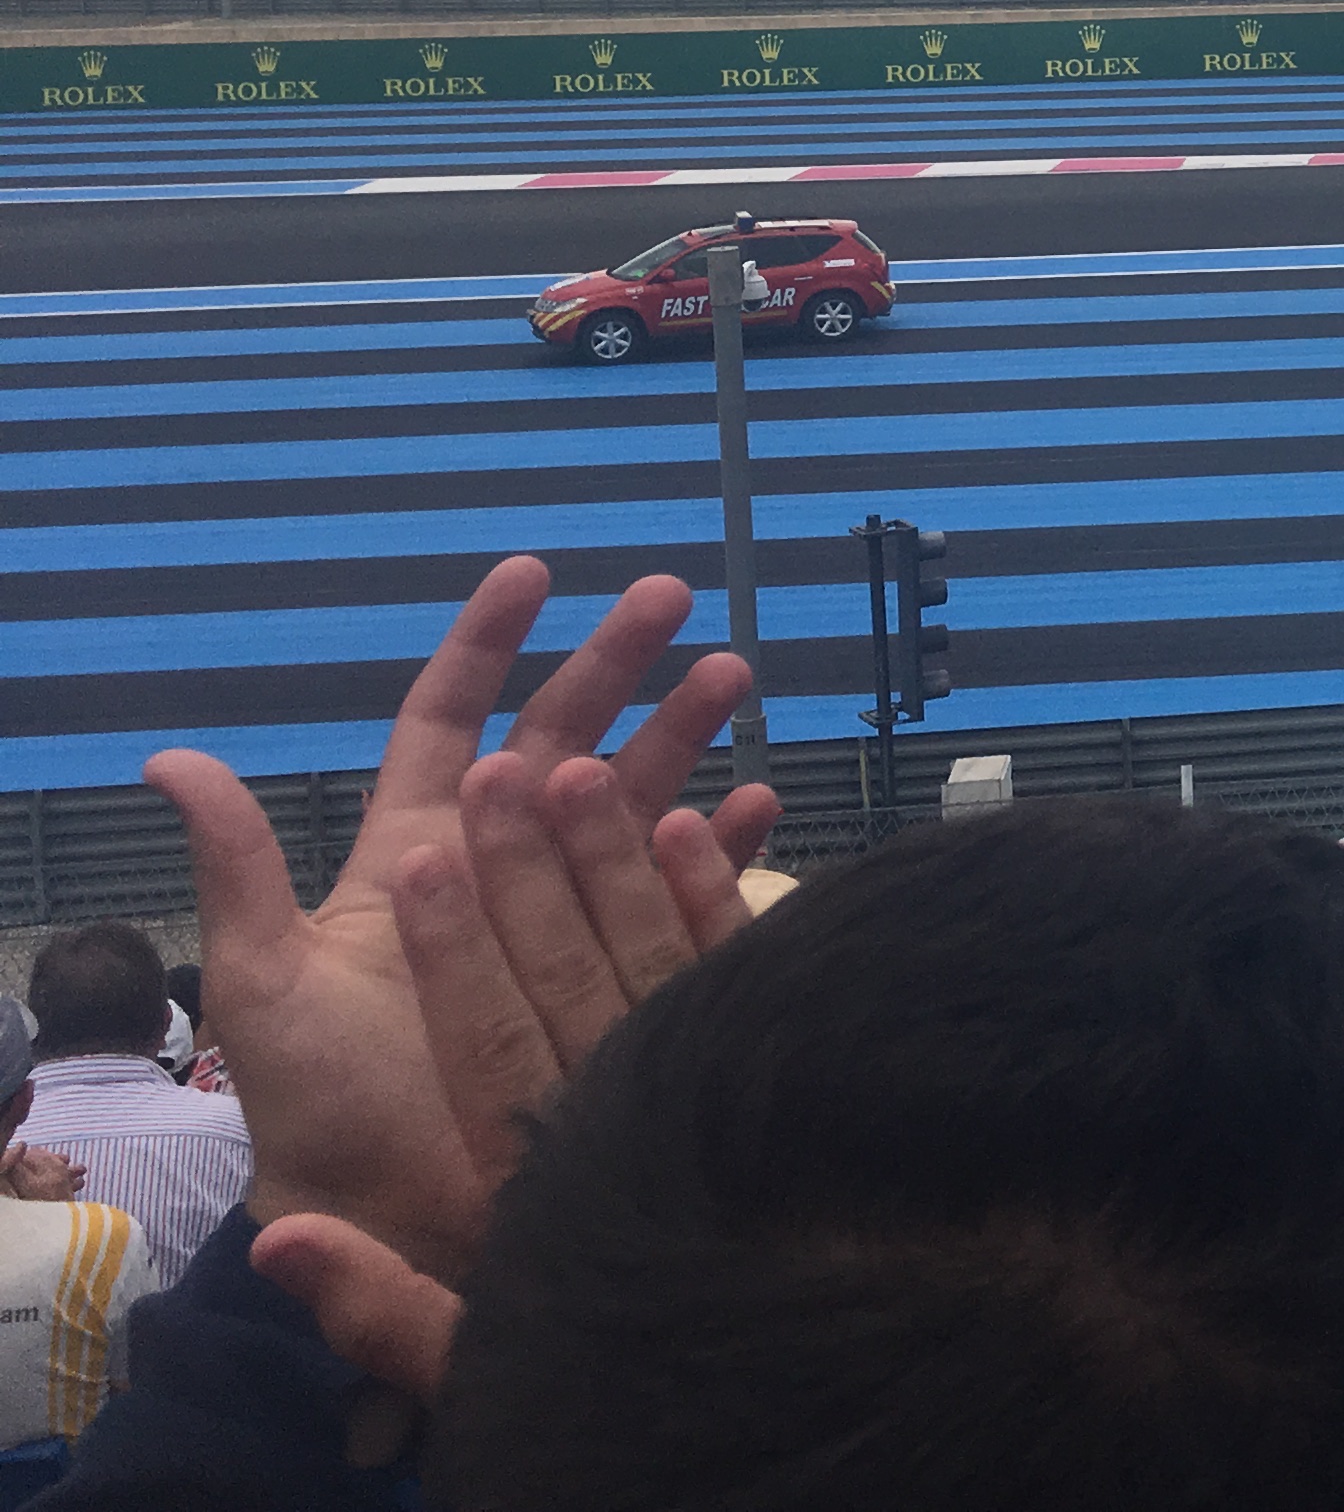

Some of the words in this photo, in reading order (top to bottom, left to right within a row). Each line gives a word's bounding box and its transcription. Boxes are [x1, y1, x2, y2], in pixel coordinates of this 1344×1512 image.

[885, 62, 982, 82] ROLEX
[1044, 57, 1139, 78] ROLEX
[1202, 52, 1295, 72] ROLEX
[383, 77, 486, 97] ROLEX
[553, 72, 653, 93] ROLEX
[719, 67, 818, 87] ROLEX
[42, 85, 145, 106] ROLEX
[215, 80, 319, 101] ROLEX
[661, 295, 709, 318] FAST
